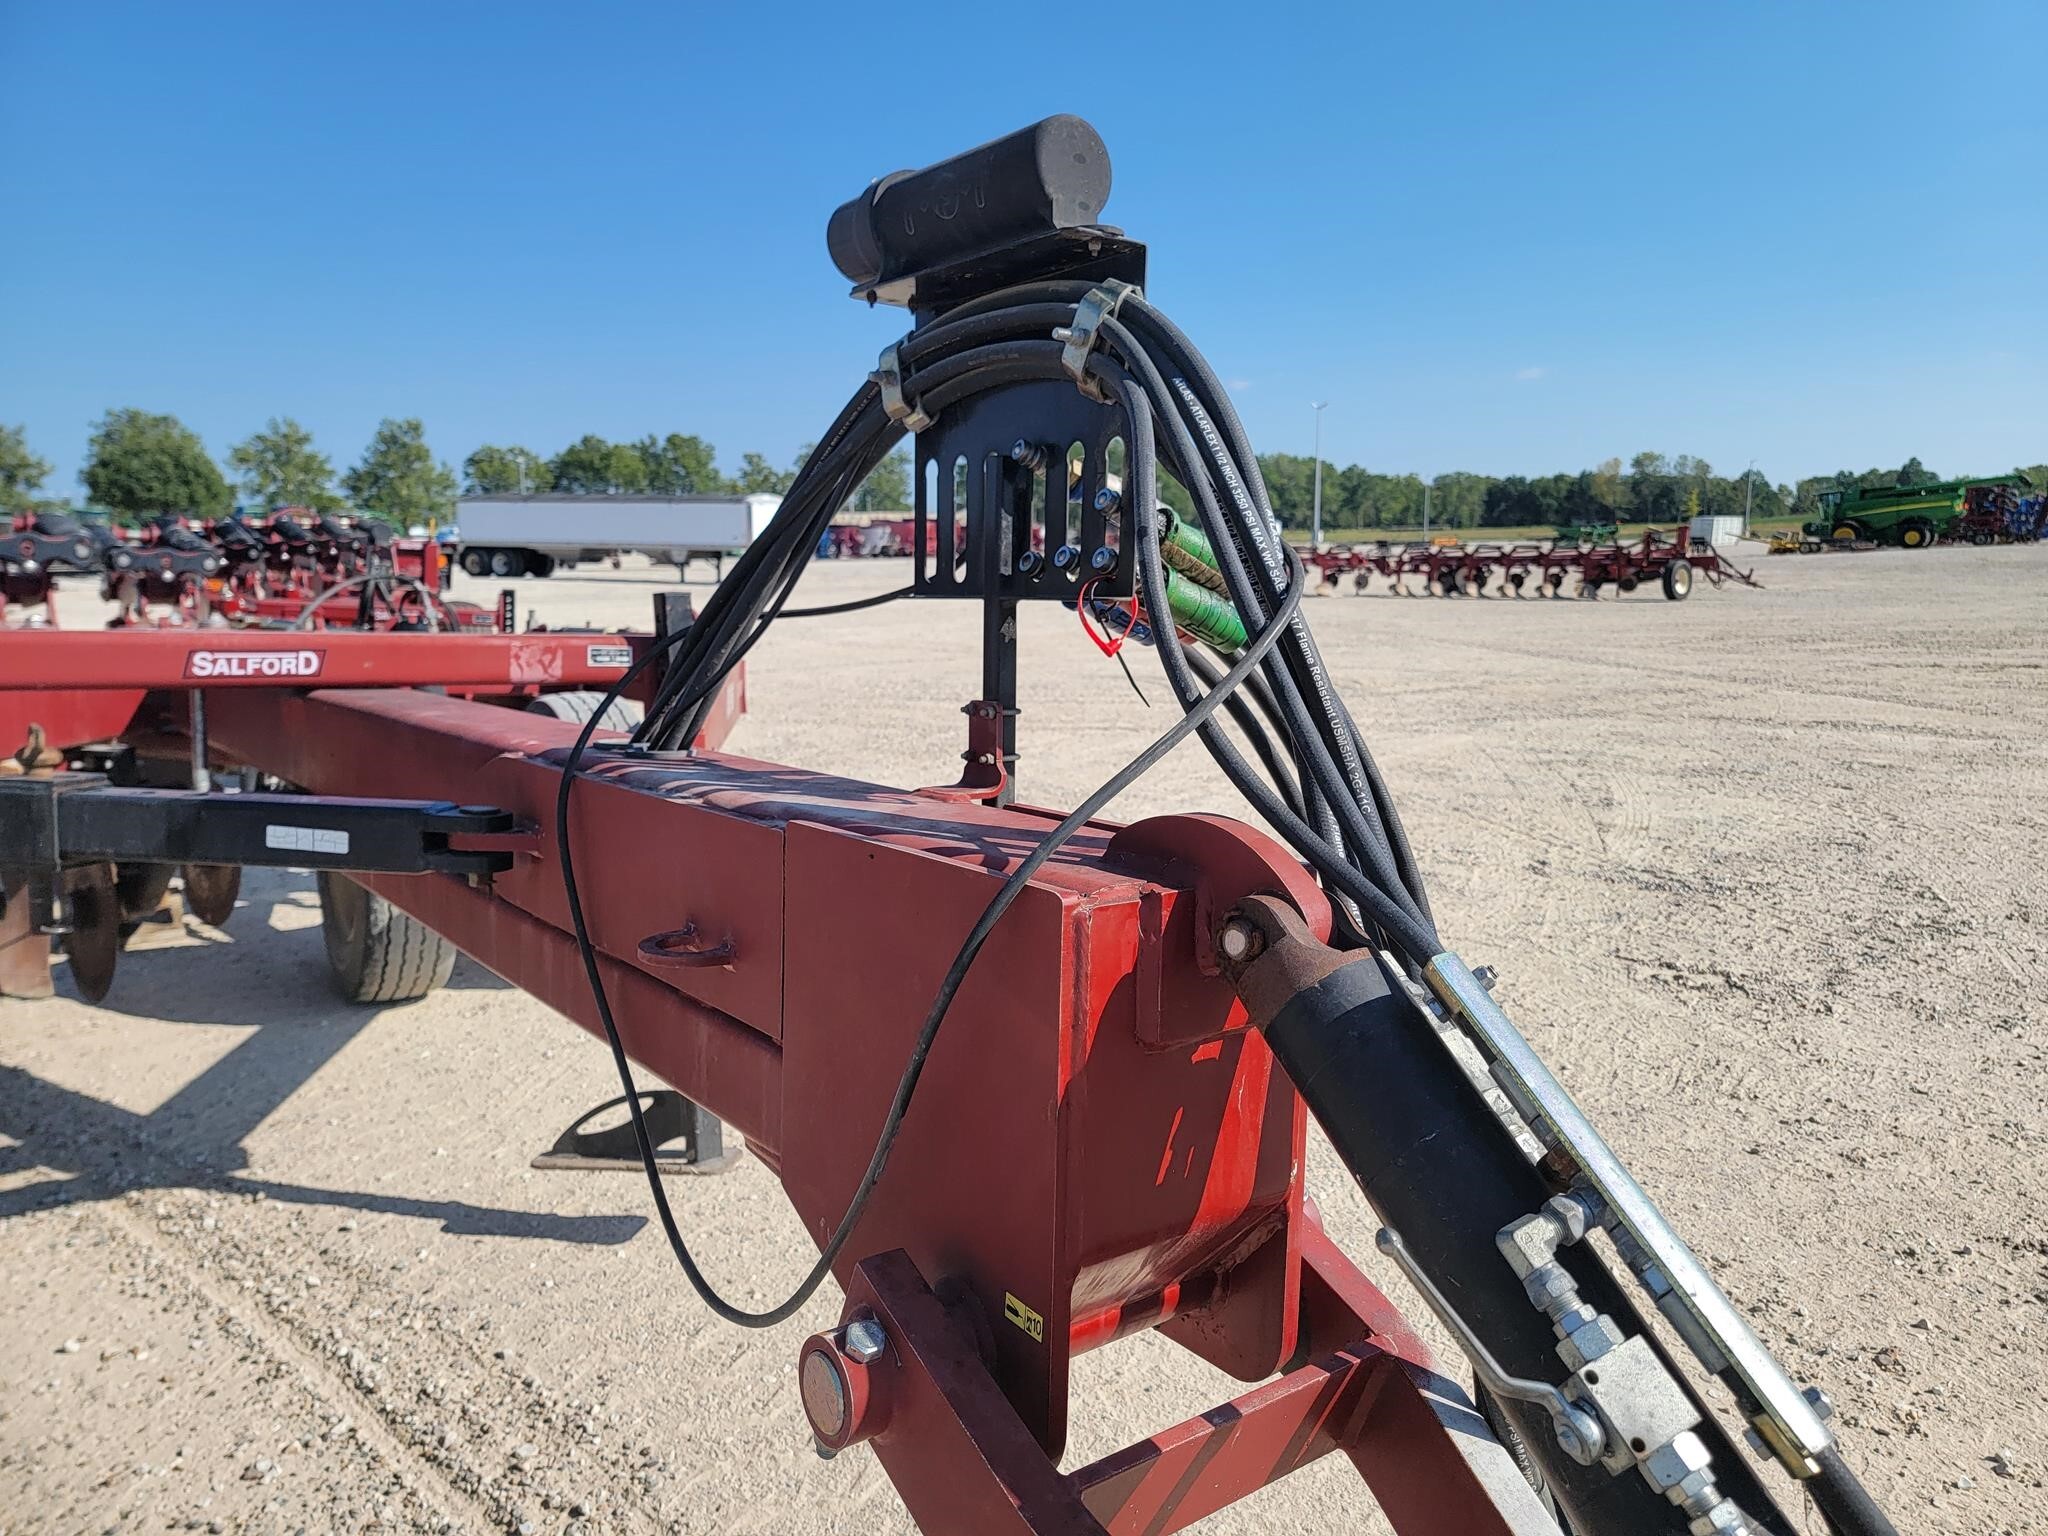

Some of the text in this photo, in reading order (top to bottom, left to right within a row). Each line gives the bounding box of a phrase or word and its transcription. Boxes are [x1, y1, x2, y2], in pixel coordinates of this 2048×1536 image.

[1172, 377, 1194, 401] ATLAS
[1190, 405, 1219, 447] ATLAFLEX
[1215, 452, 1228, 465] 1/2
[1220, 464, 1239, 488] INCH
[1232, 488, 1248, 510] 3250
[1242, 510, 1257, 527] PSI
[1250, 527, 1268, 551] MAX
[1261, 550, 1275, 568] WP
[1269, 568, 1286, 593] SAE
[1295, 631, 1315, 665] Flame
[191, 651, 319, 677] SALFORD
[1309, 664, 1336, 720] Resistant
[1330, 719, 1356, 771] USMSHA
[1352, 771, 1371, 815] 2G-11C
[1514, 1444, 1530, 1467] MAX
